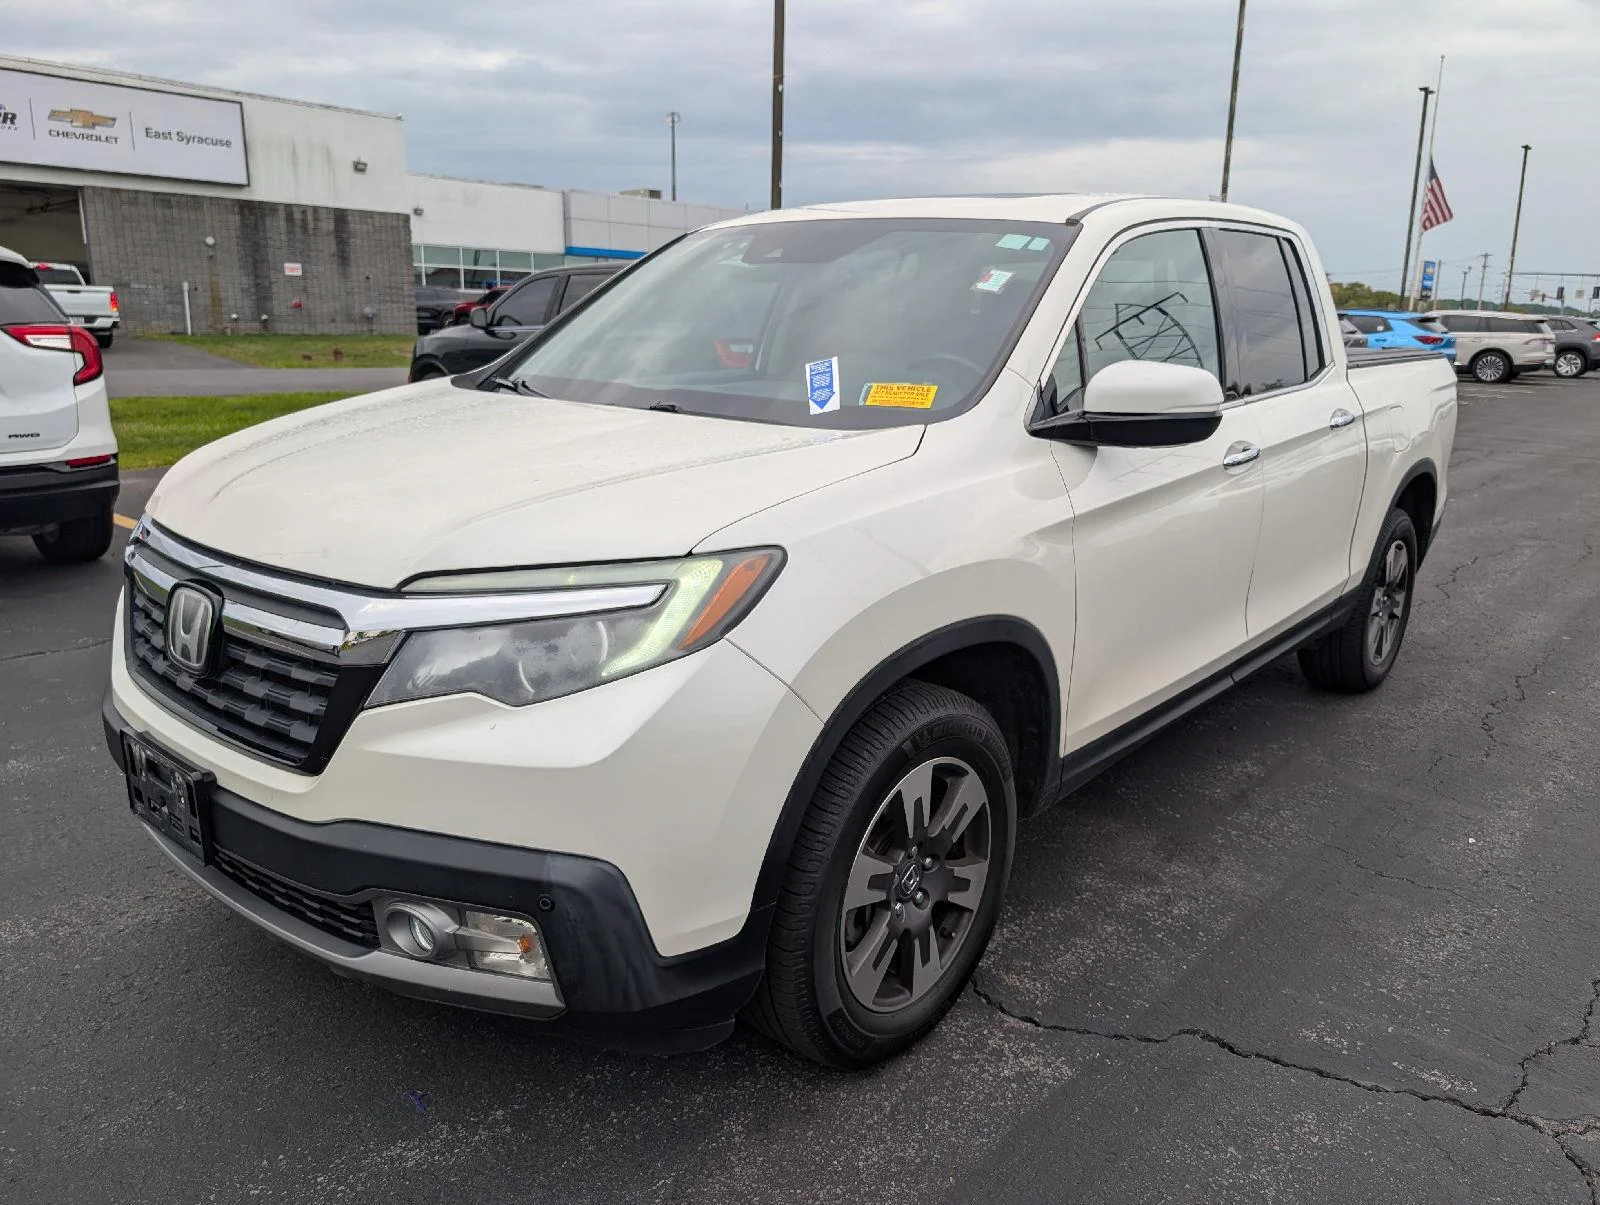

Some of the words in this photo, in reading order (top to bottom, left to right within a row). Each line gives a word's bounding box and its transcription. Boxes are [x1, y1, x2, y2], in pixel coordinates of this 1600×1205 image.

[48, 129, 119, 144] CHEVROLET
[145, 127, 173, 141] East
[176, 130, 232, 148] Syracuse
[896, 385, 932, 393] VEHICLE
